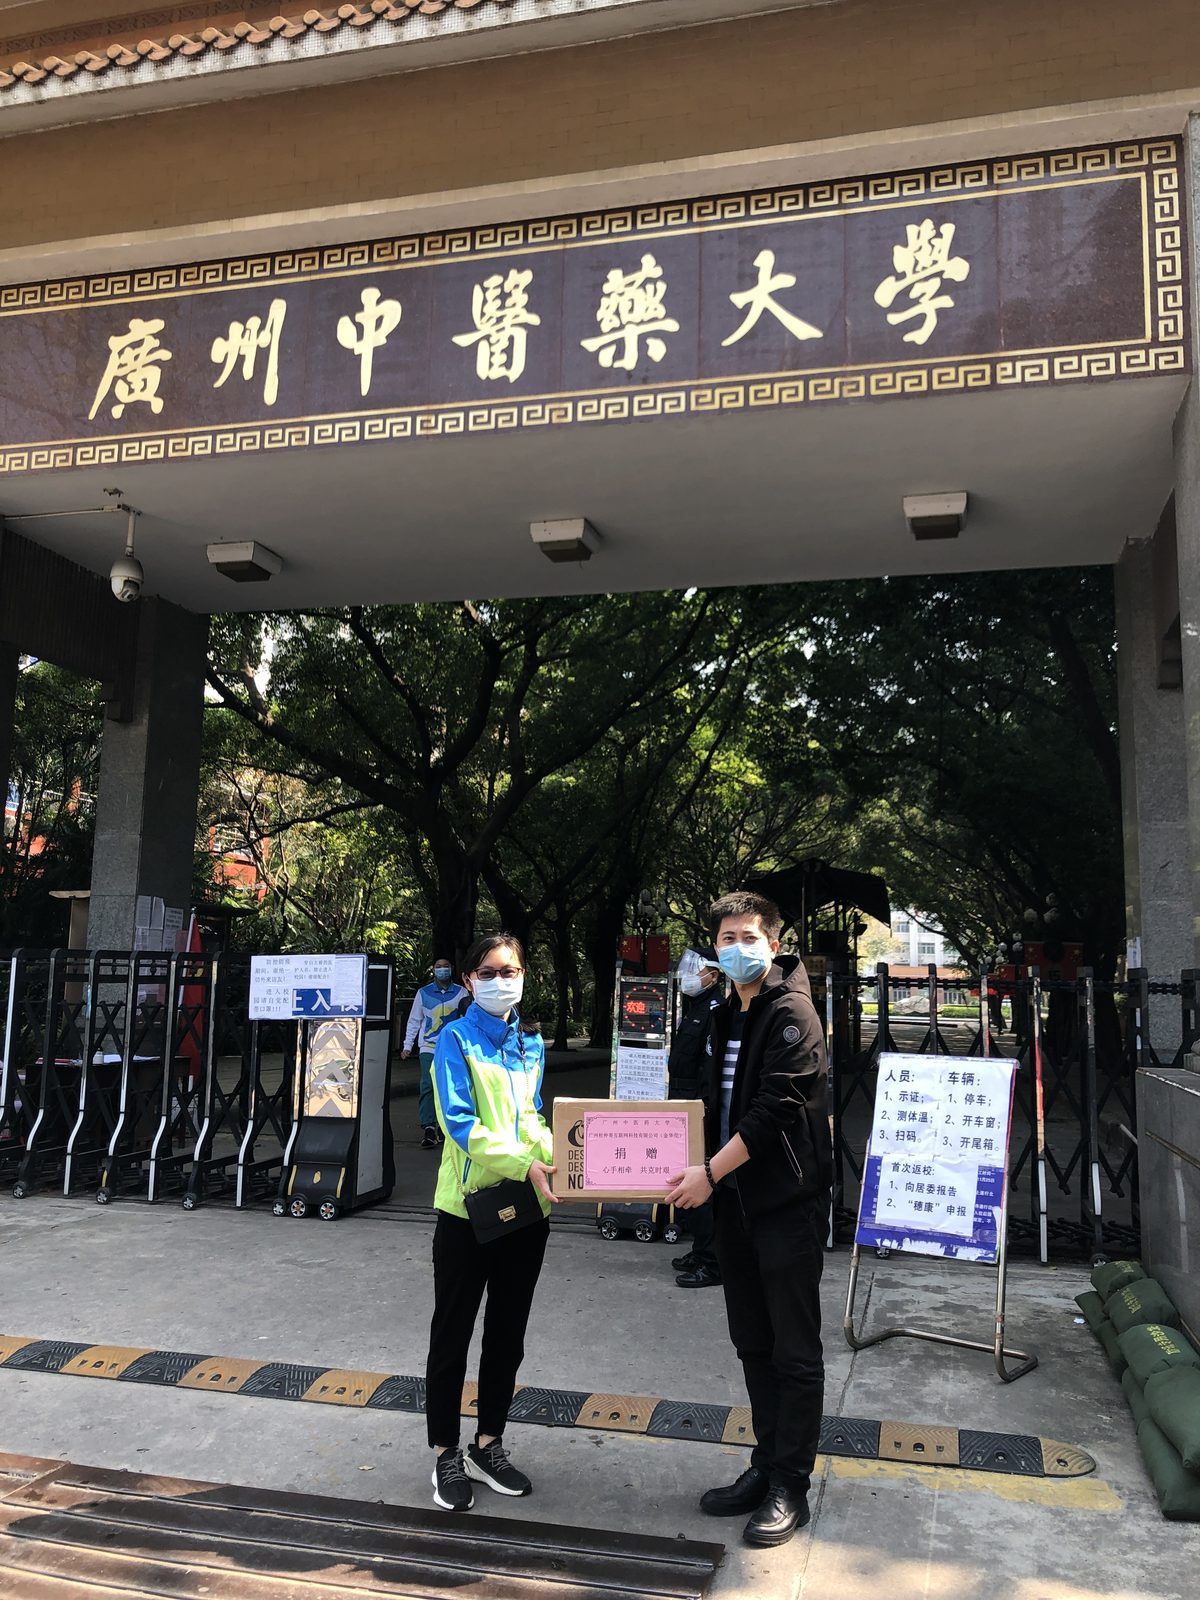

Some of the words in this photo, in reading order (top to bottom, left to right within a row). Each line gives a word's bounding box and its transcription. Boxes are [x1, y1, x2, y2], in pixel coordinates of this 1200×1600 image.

[88, 218, 970, 421] 廣州中醫藥大學
